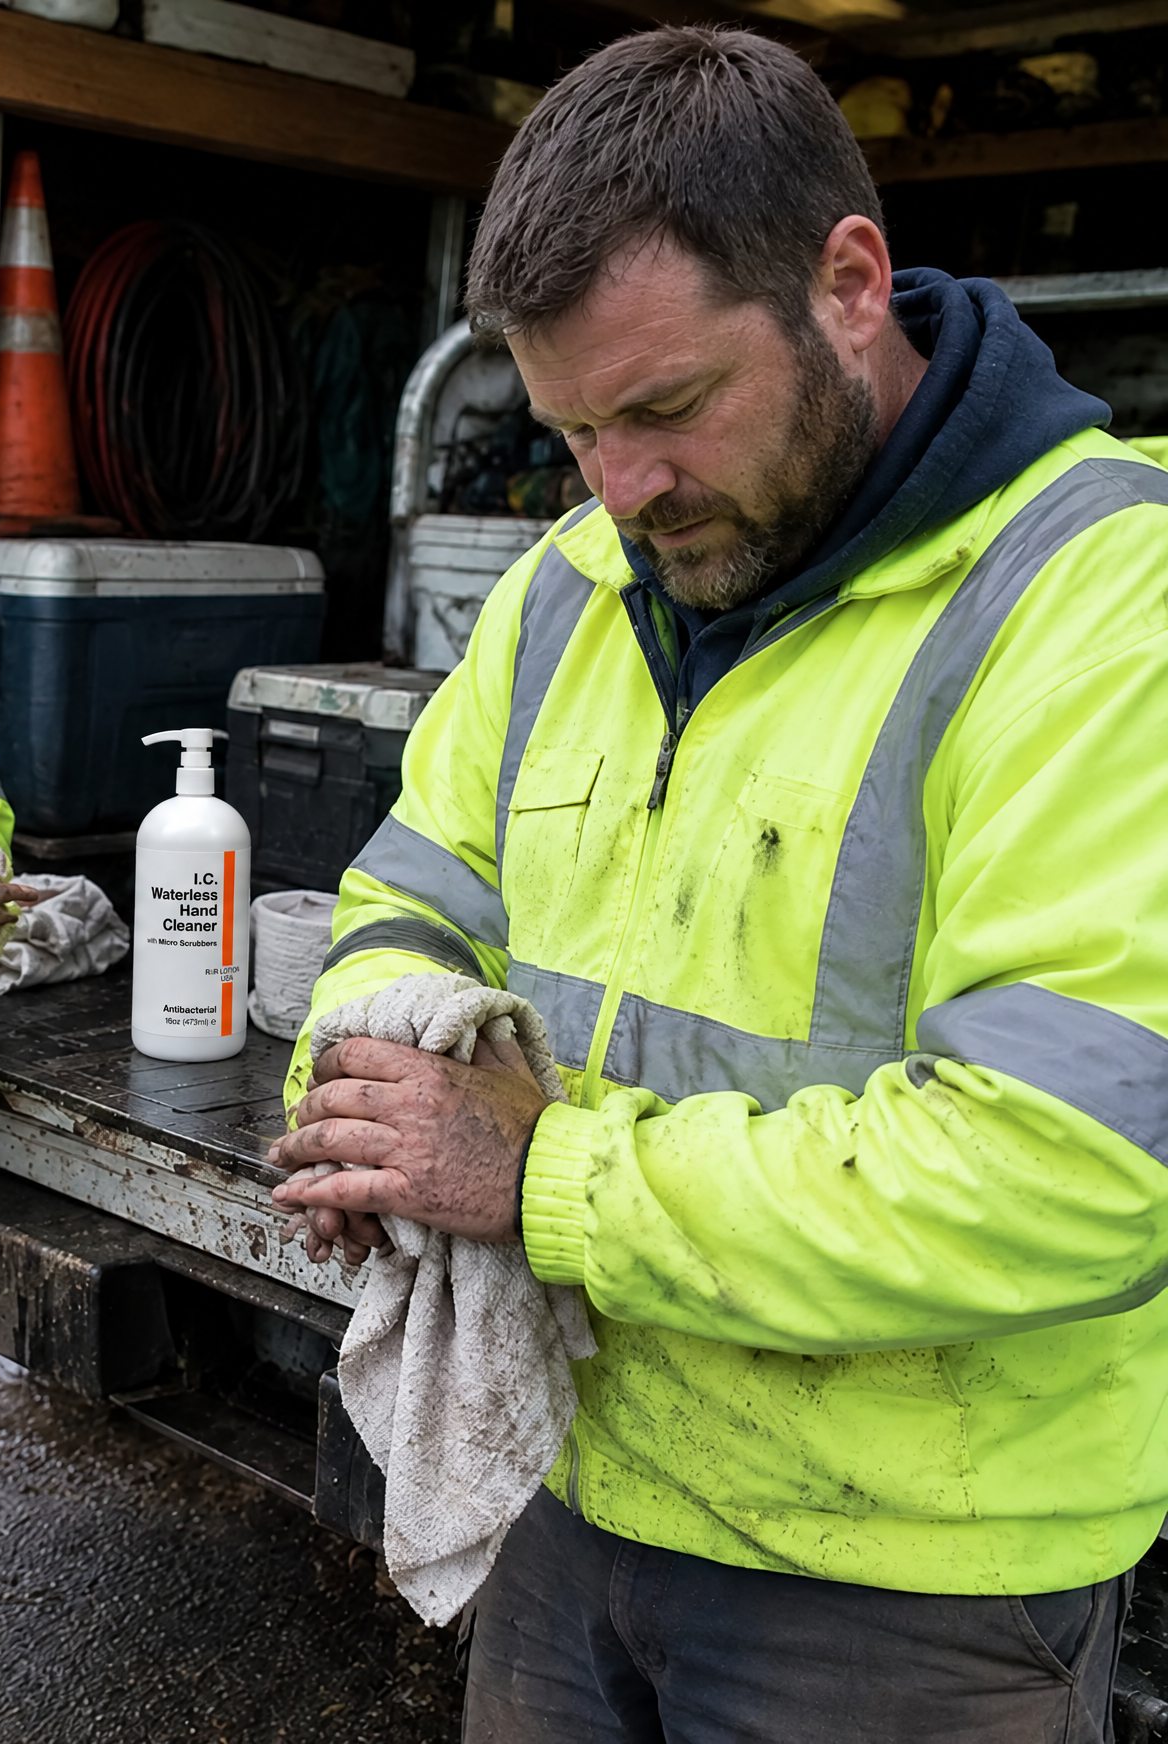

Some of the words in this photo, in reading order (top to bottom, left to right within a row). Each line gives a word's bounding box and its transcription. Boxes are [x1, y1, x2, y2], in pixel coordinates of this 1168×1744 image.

[194, 872, 218, 885] I.C.
[151, 886, 218, 901] Waterless
[180, 904, 218, 917] Hand
[163, 918, 218, 932] Cleaner
[158, 938, 178, 946] Micro
[179, 939, 218, 947] Scrubbers
[163, 1004, 217, 1014] Antibacterial
[165, 1017, 181, 1025] 16oz
